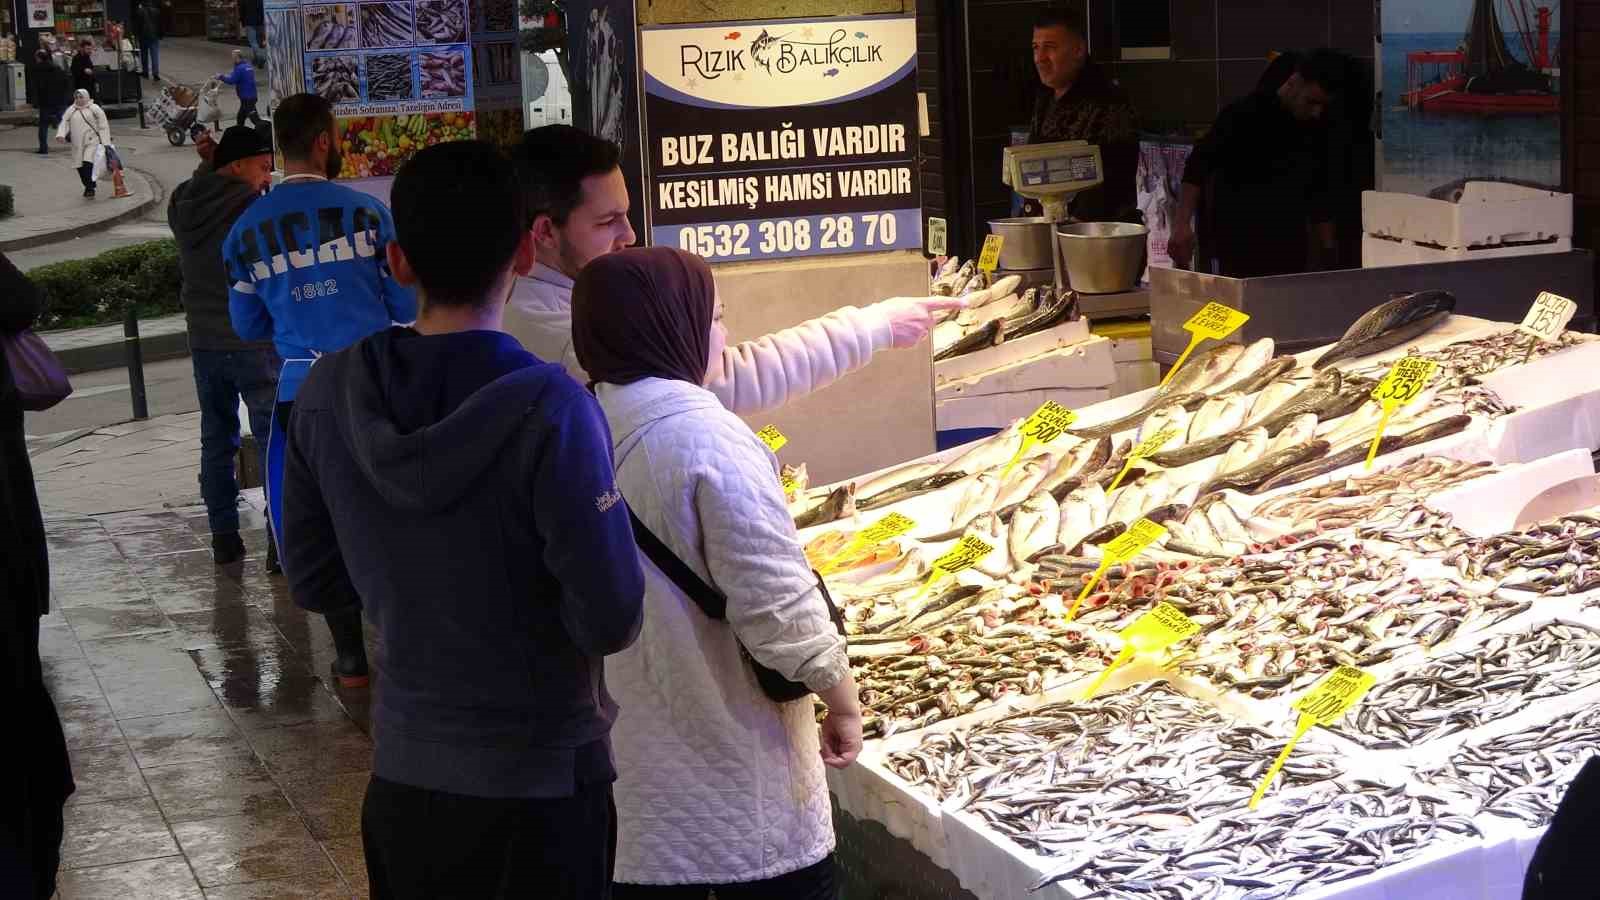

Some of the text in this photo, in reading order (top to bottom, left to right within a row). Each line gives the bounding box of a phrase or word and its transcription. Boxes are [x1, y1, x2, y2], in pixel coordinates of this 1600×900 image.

[681, 29, 882, 79] RIZIK BALIKÇILIK
[661, 121, 906, 166] BUZ BALIĞI VARDIR
[837, 167, 911, 198] VARDIR
[679, 213, 897, 258] 0532 308 28 70
[1537, 292, 1569, 312] OLTA
[1527, 307, 1562, 336] 150
[1382, 377, 1424, 402] 350
[1026, 421, 1062, 444] 500
